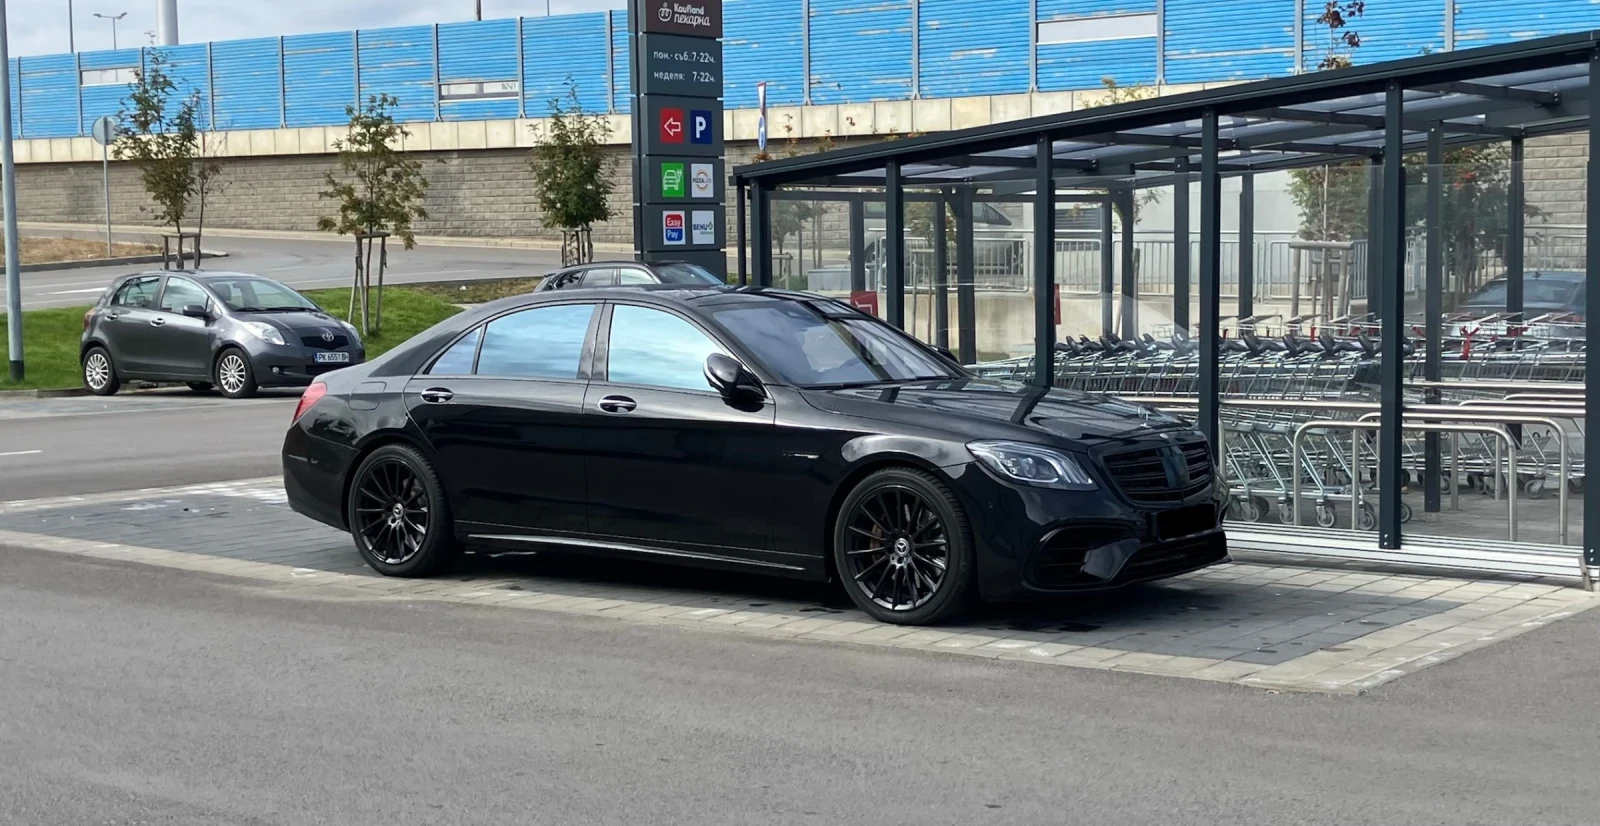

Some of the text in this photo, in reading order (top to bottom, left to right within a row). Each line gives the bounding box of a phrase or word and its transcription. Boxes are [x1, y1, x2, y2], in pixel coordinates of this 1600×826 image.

[674, 3, 704, 14] Kaufland
[674, 14, 710, 27] пекарна
[654, 72, 685, 81] неделя:
[696, 116, 706, 138] P
[667, 217, 681, 227] Easy
[667, 230, 678, 239] Pay
